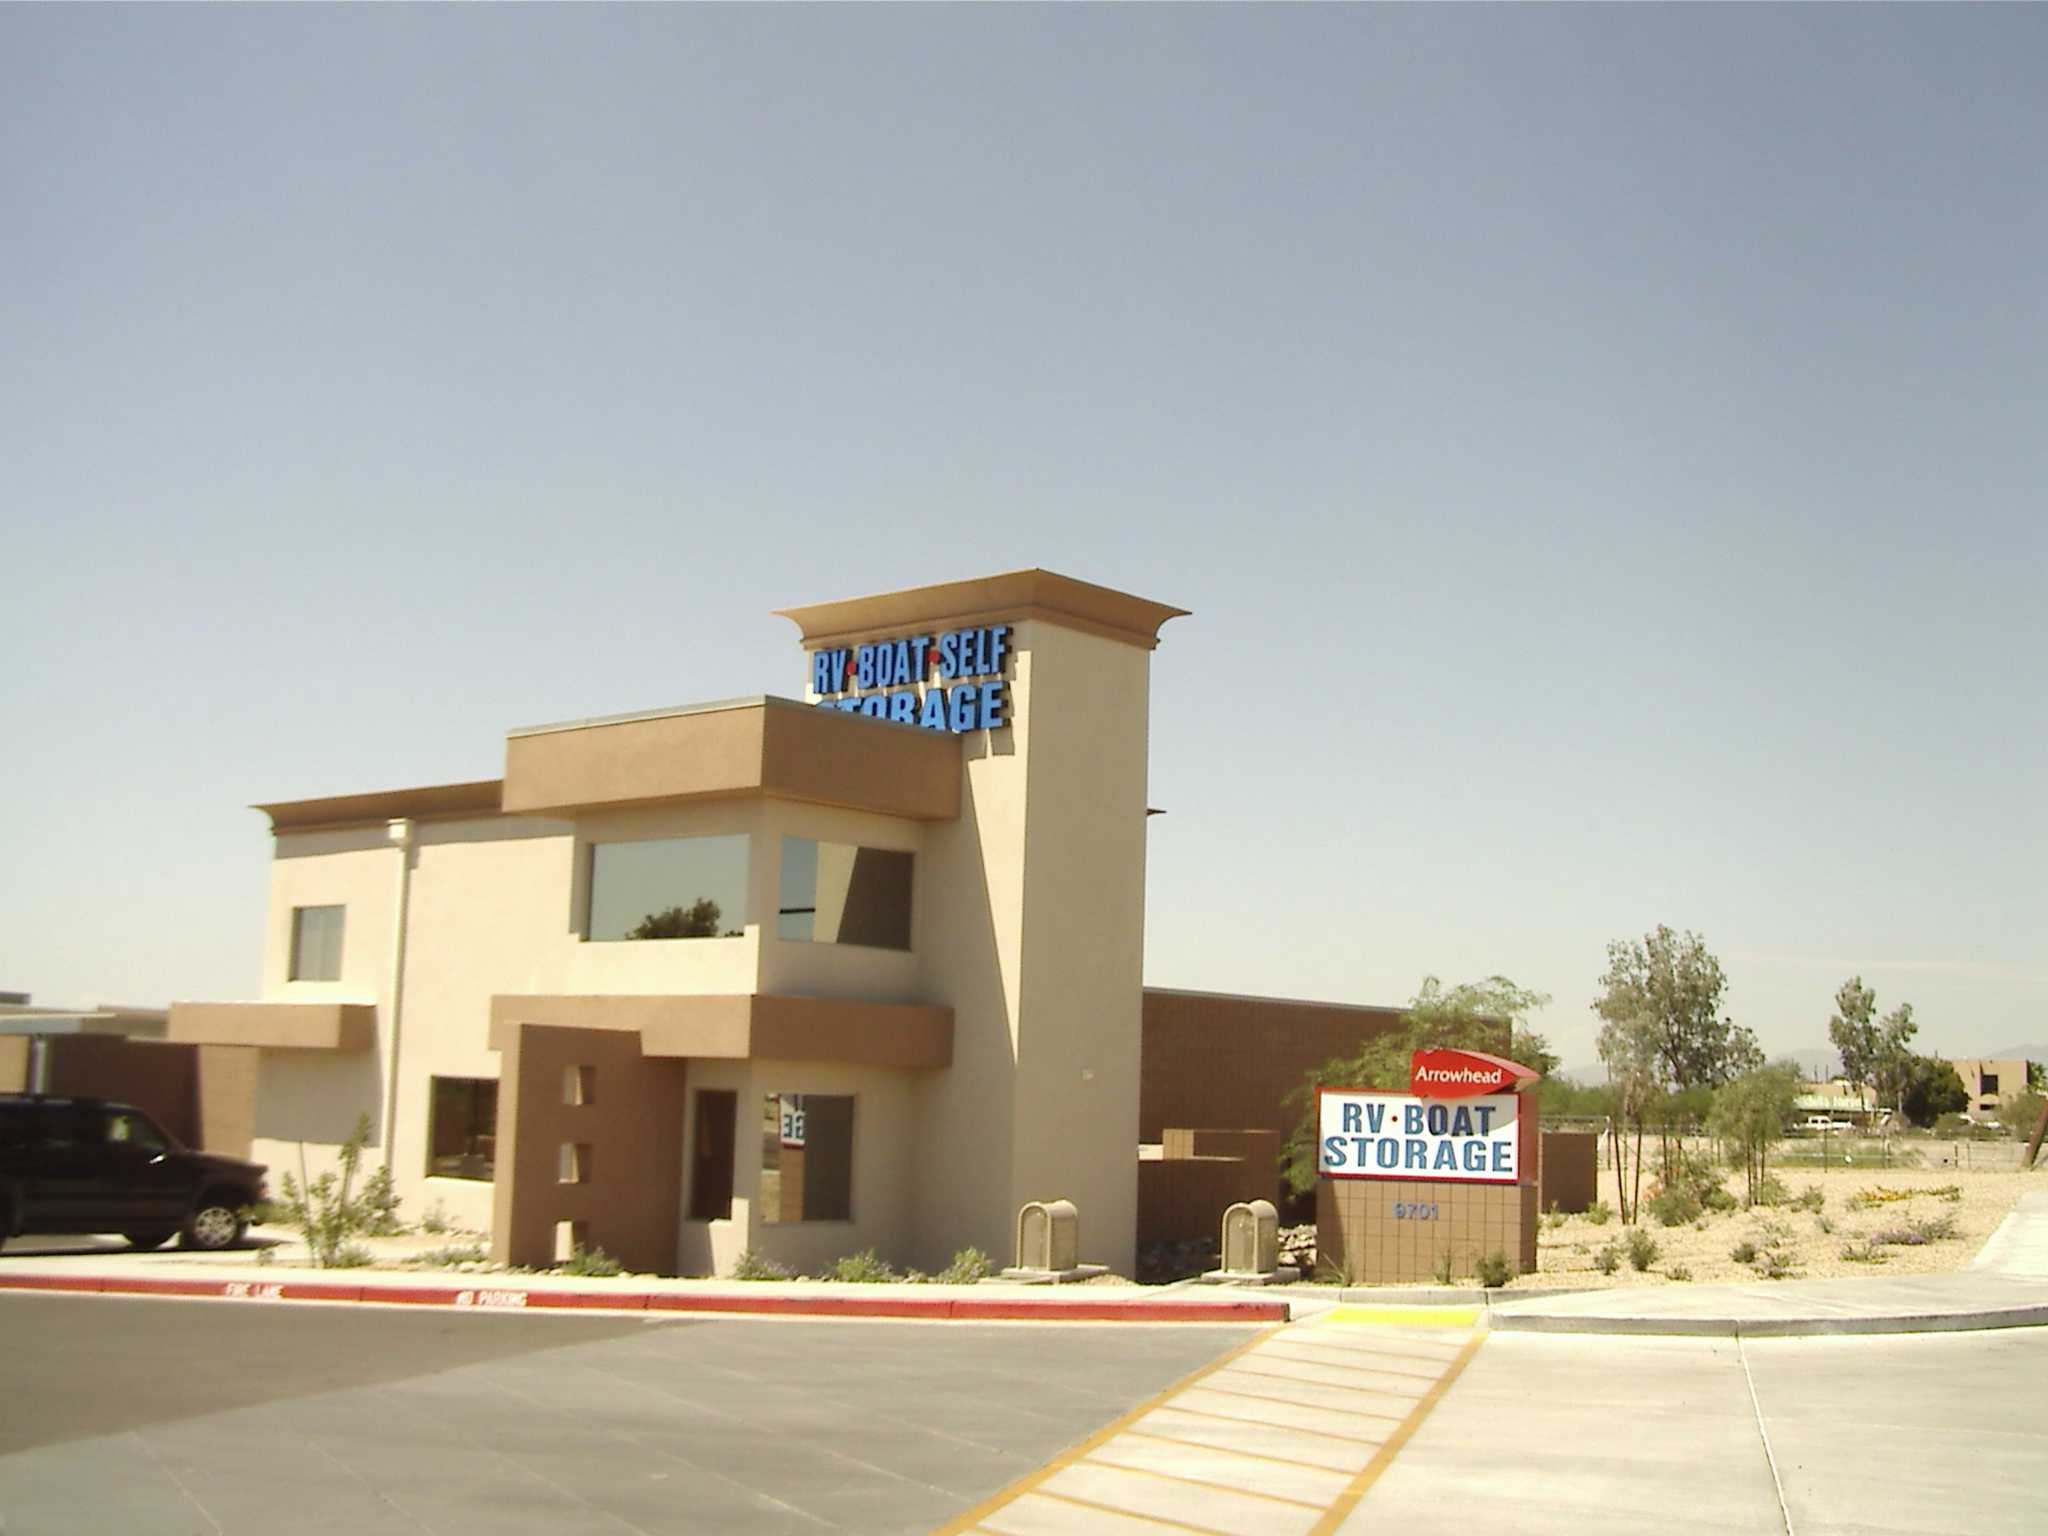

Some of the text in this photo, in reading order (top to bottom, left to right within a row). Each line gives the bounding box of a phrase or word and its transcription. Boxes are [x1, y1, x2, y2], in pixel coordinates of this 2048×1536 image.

[813, 627, 1009, 693] RV BOAT SELF
[816, 682, 1007, 732] RAGE
[1415, 1066, 1502, 1084] Arrowhead
[1343, 1103, 1496, 1137] RV BOAT
[1324, 1136, 1513, 1172] STORAGE
[1394, 1203, 1439, 1220] 9701
[478, 1291, 527, 1306] PARKING
